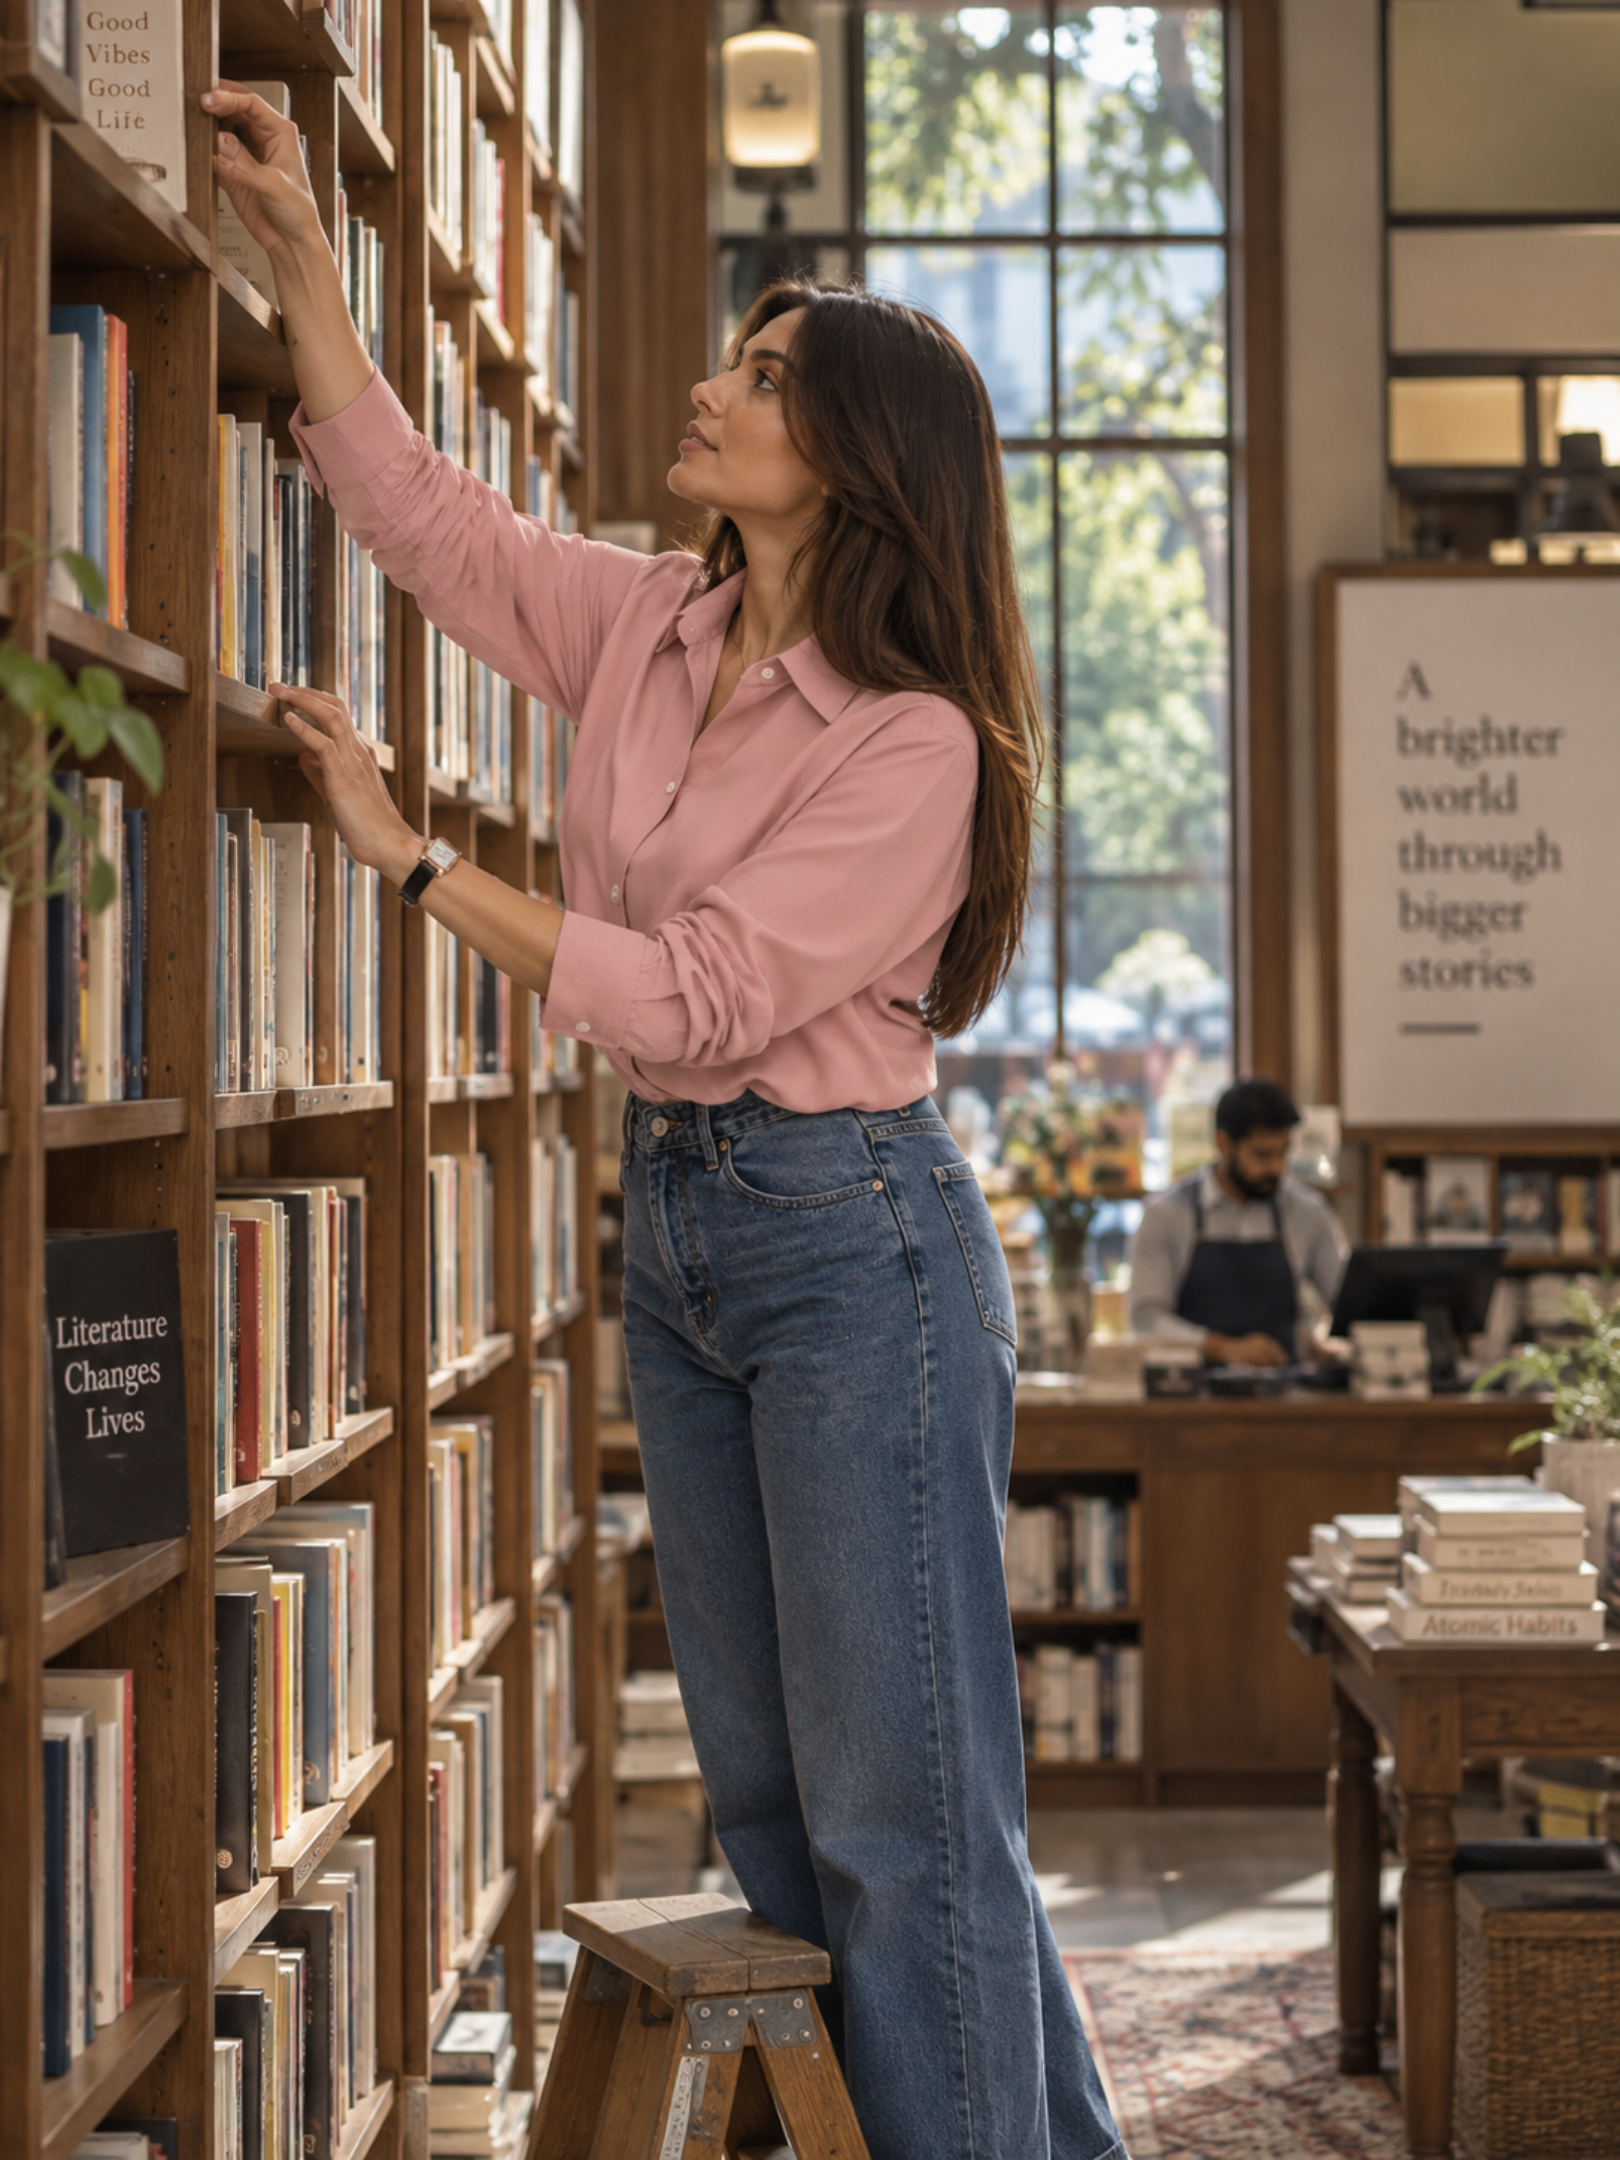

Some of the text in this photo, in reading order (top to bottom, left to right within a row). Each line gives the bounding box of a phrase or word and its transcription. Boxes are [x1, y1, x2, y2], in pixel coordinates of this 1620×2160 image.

[86, 11, 149, 31] Good
[86, 43, 150, 64] Vibes
[88, 77, 151, 97] Good
[1397, 661, 1432, 701] A
[1397, 715, 1564, 767] brighter
[1397, 772, 1519, 815] world
[1397, 829, 1563, 882] through
[1398, 889, 1527, 942] bigger
[1399, 950, 1535, 990] stories
[56, 1314, 168, 1349] Literature
[64, 1359, 161, 1396] Changes
[86, 1406, 146, 1439] Lives
[1422, 1614, 1500, 1636] Atomic
